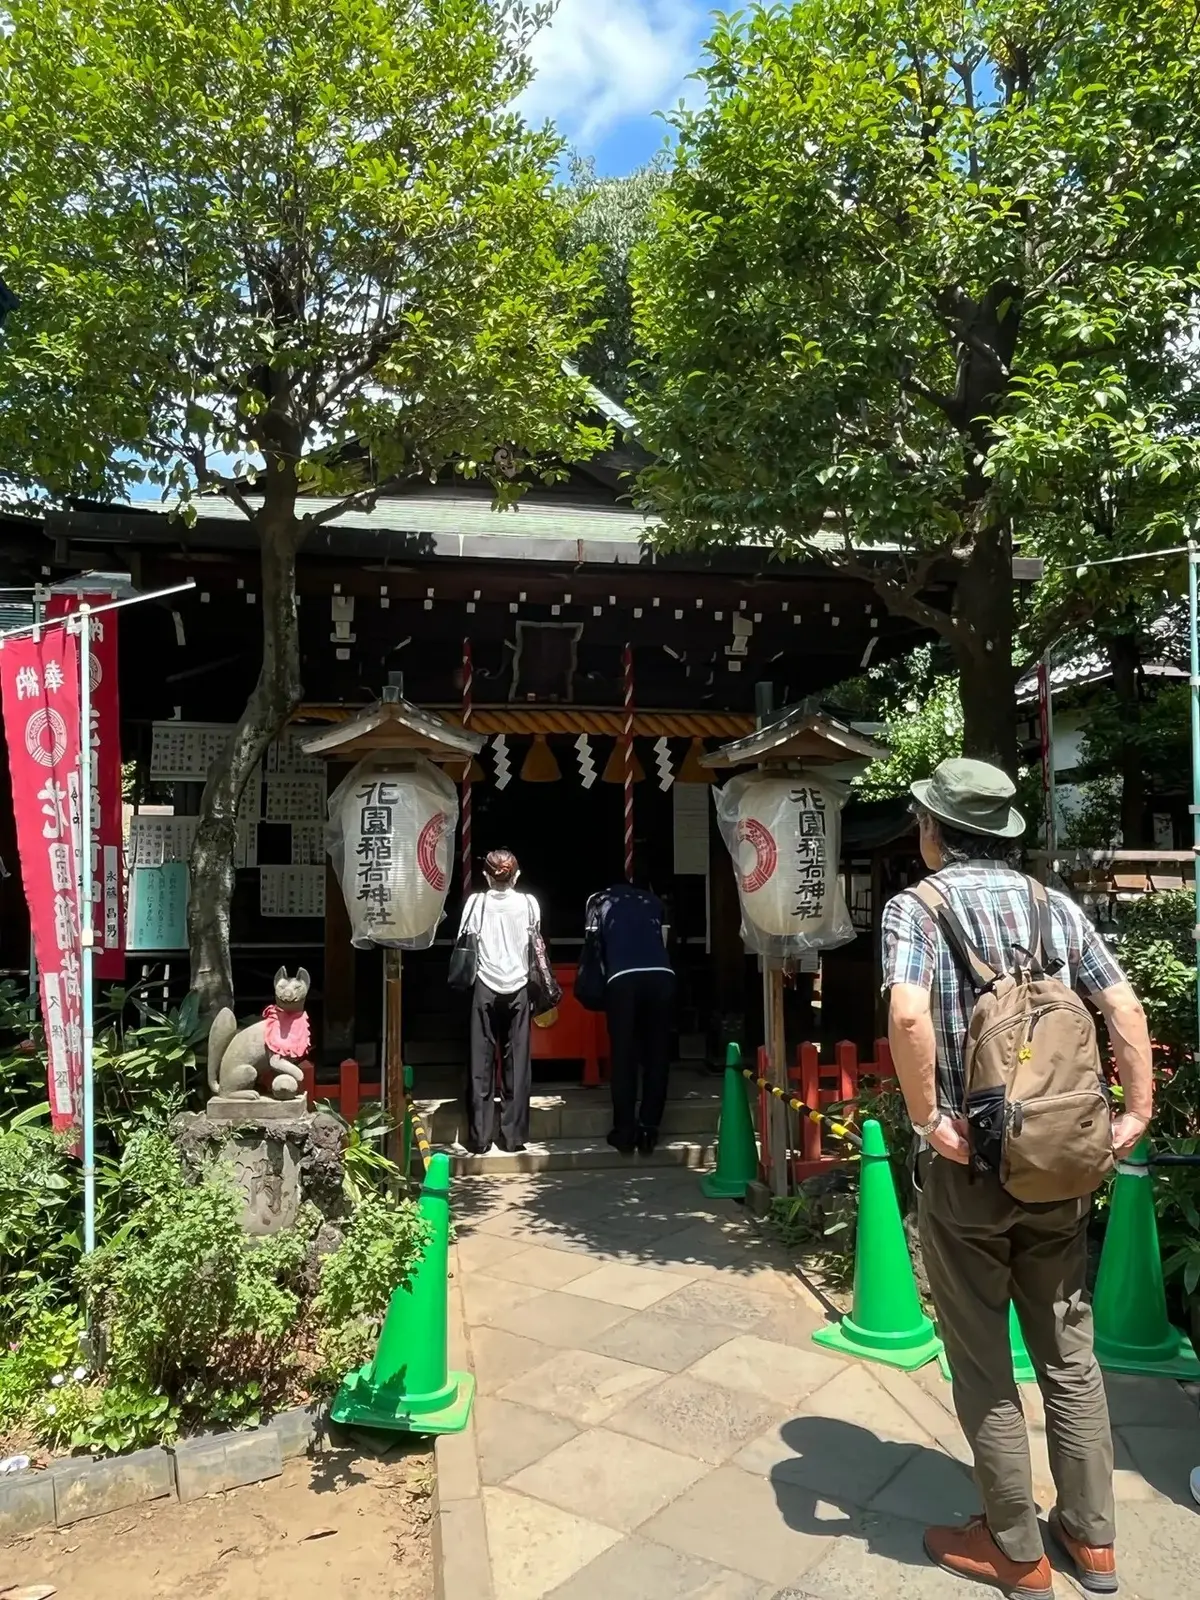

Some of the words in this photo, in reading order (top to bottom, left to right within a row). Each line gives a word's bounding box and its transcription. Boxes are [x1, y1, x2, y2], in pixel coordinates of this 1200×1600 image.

[355, 782, 400, 927] 花園稲荷神社
[788, 787, 826, 921] 花園稲荷神社
